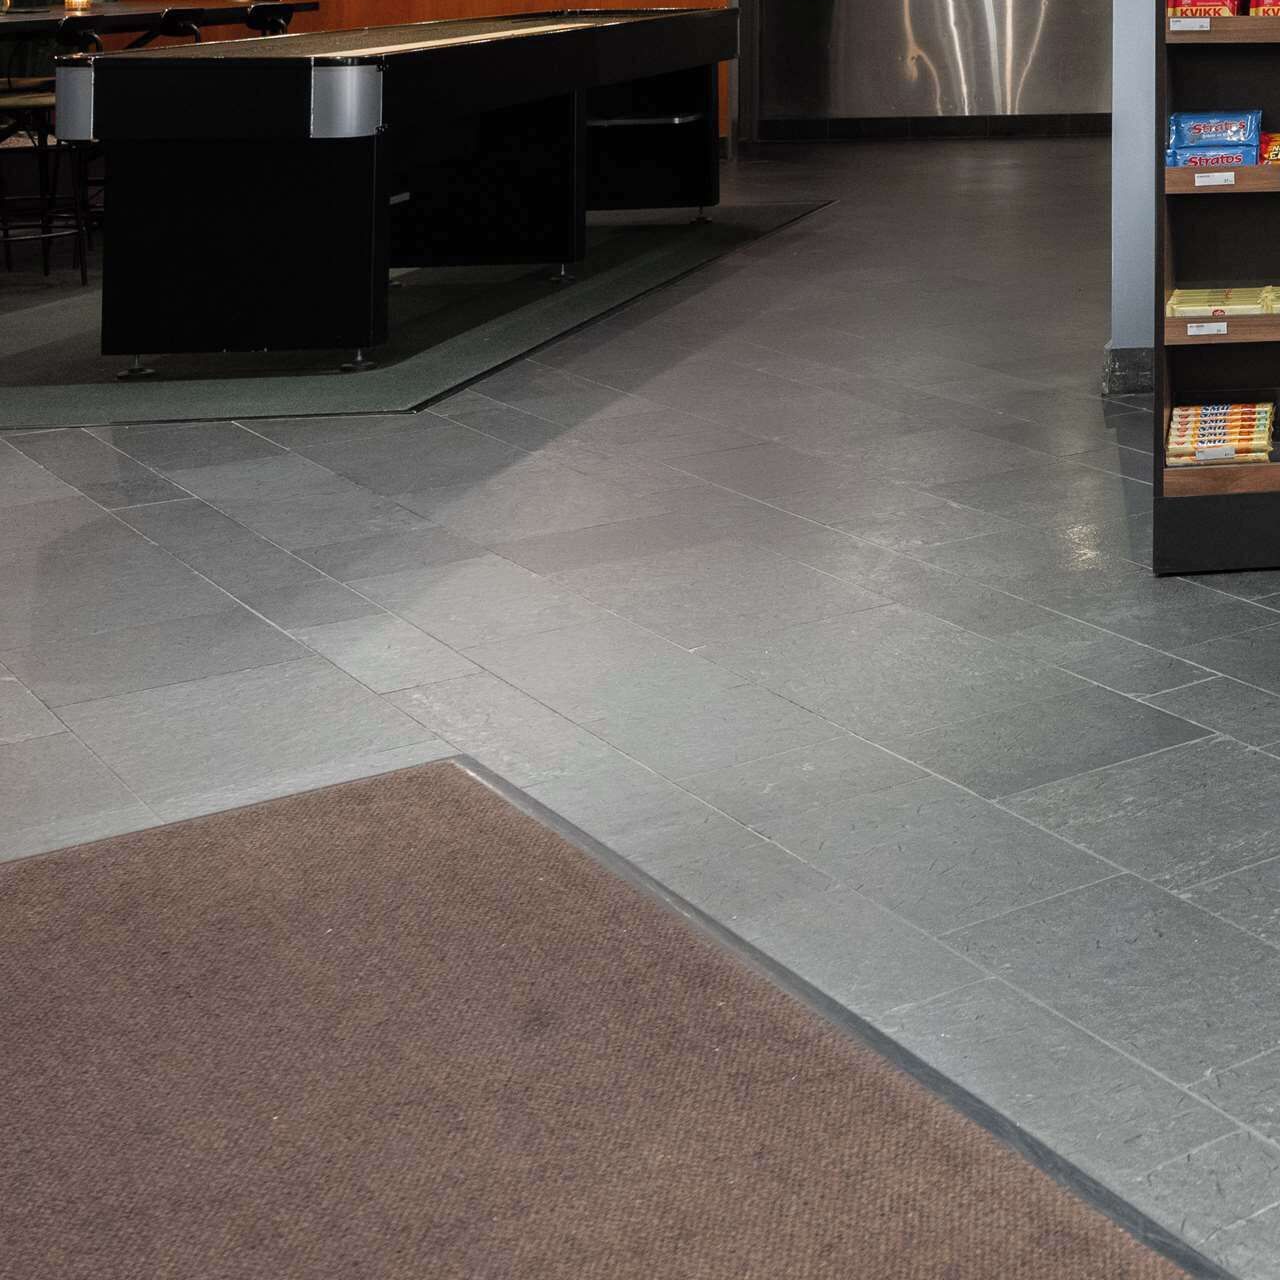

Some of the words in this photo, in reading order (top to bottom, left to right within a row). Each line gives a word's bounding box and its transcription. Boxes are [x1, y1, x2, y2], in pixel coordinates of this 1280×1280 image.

[1180, 7, 1222, 17] KVIKK
[1192, 120, 1246, 134] Strats
[1188, 154, 1242, 167] Stratos
